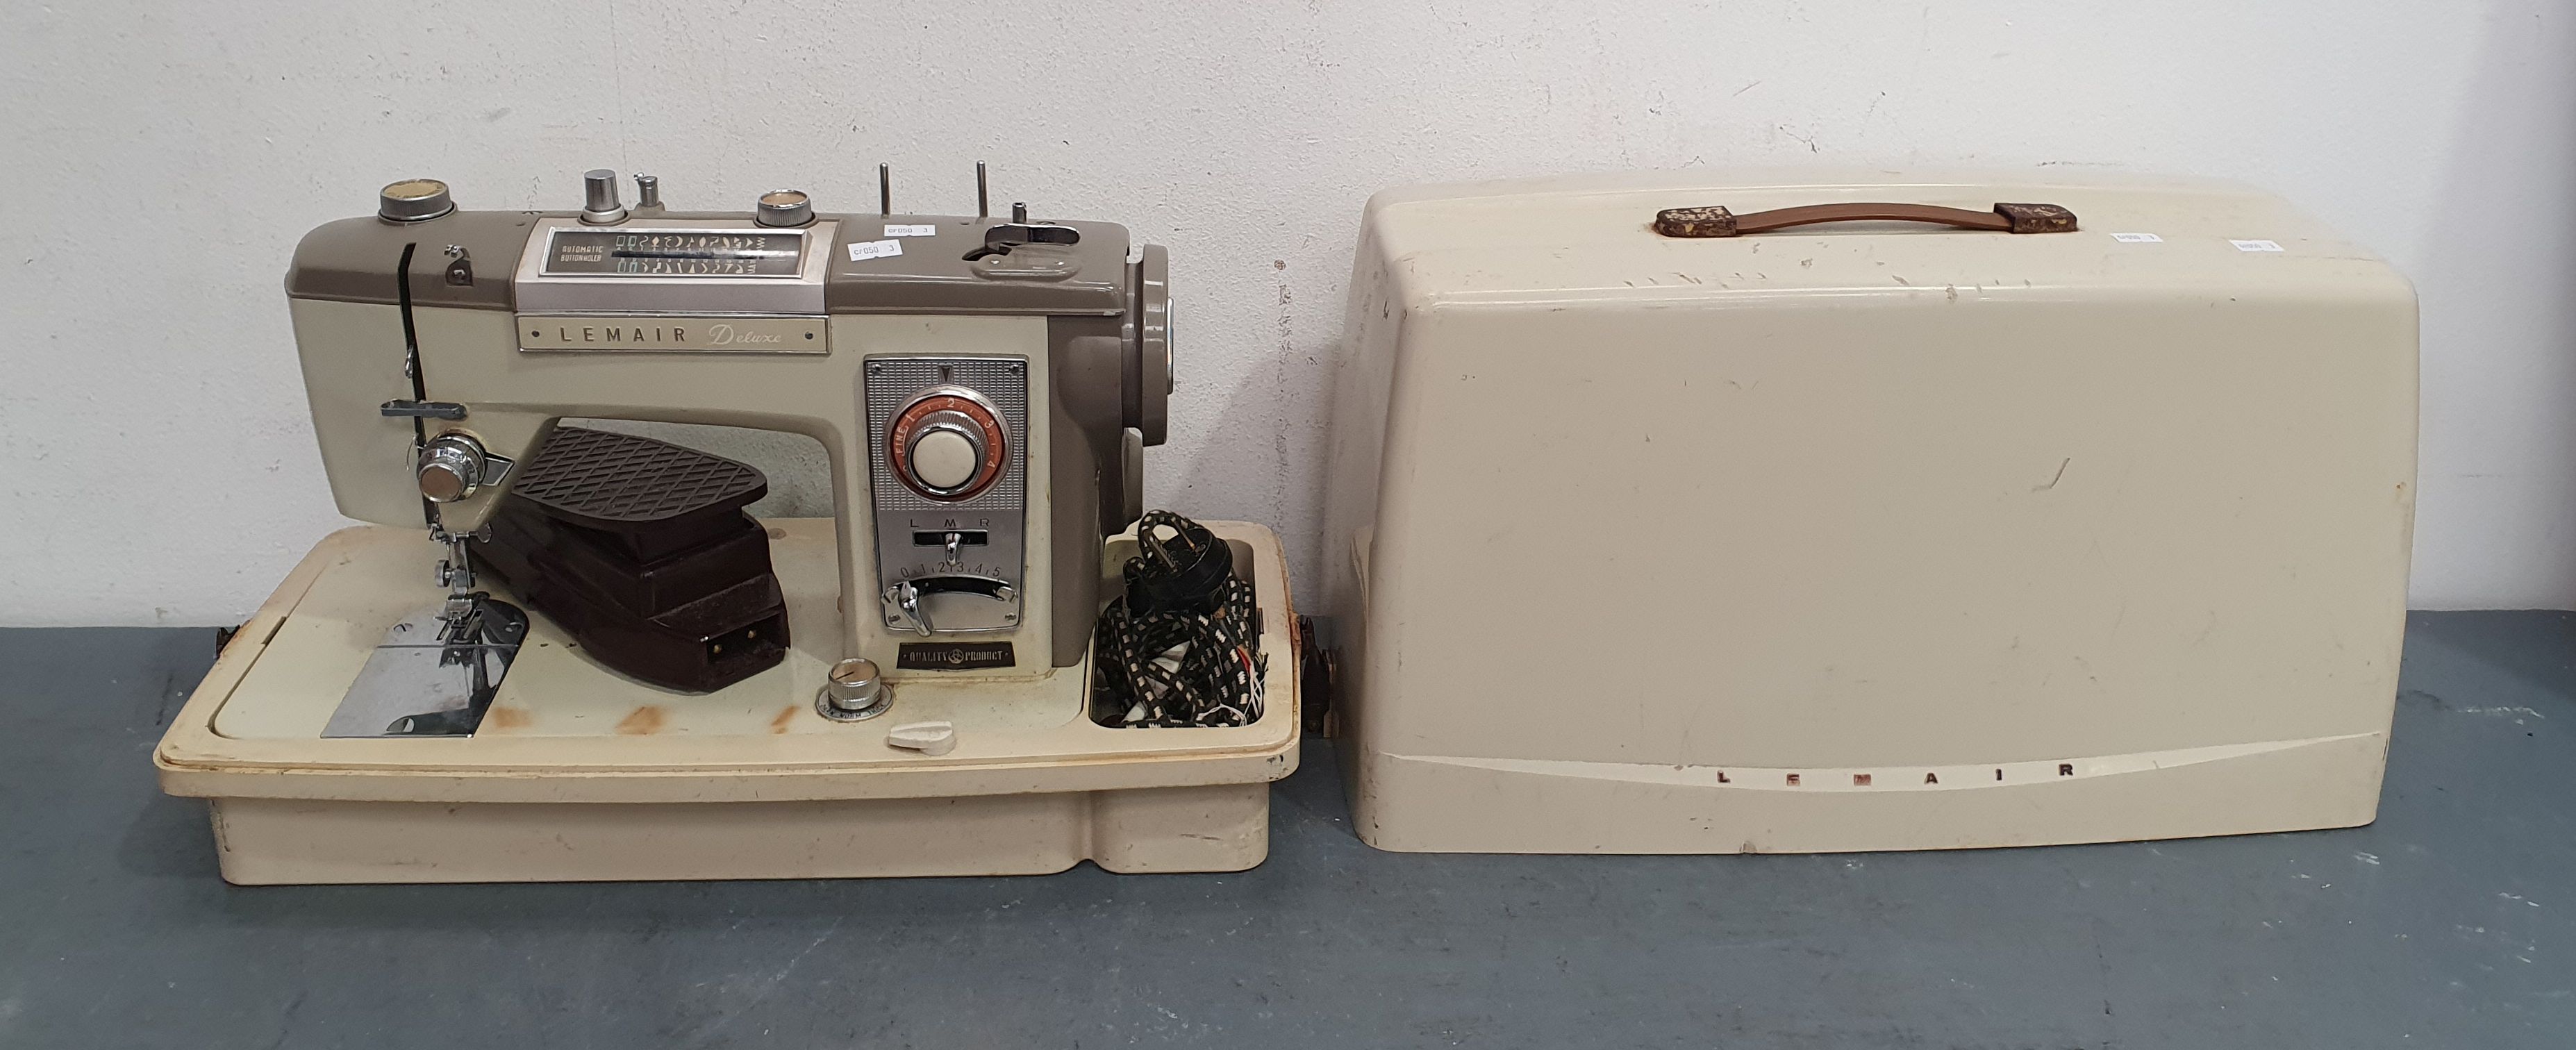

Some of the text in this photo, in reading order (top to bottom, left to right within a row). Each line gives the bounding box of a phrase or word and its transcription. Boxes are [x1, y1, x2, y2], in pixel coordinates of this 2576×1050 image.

[560, 324, 782, 346] LEMAIR Deluxe
[947, 397, 956, 408] 2
[984, 419, 995, 428] 3
[895, 426, 907, 453] FINE
[987, 460, 996, 469] 4
[910, 518, 990, 528] L M R
[900, 567, 910, 578] 0
[938, 562, 946, 573] 2
[957, 561, 965, 573] 3
[975, 562, 983, 574] 4
[992, 566, 1002, 577] 5
[909, 650, 1003, 662] QUALITY PRODUCT
[1717, 762, 2074, 787] LEMAIR
